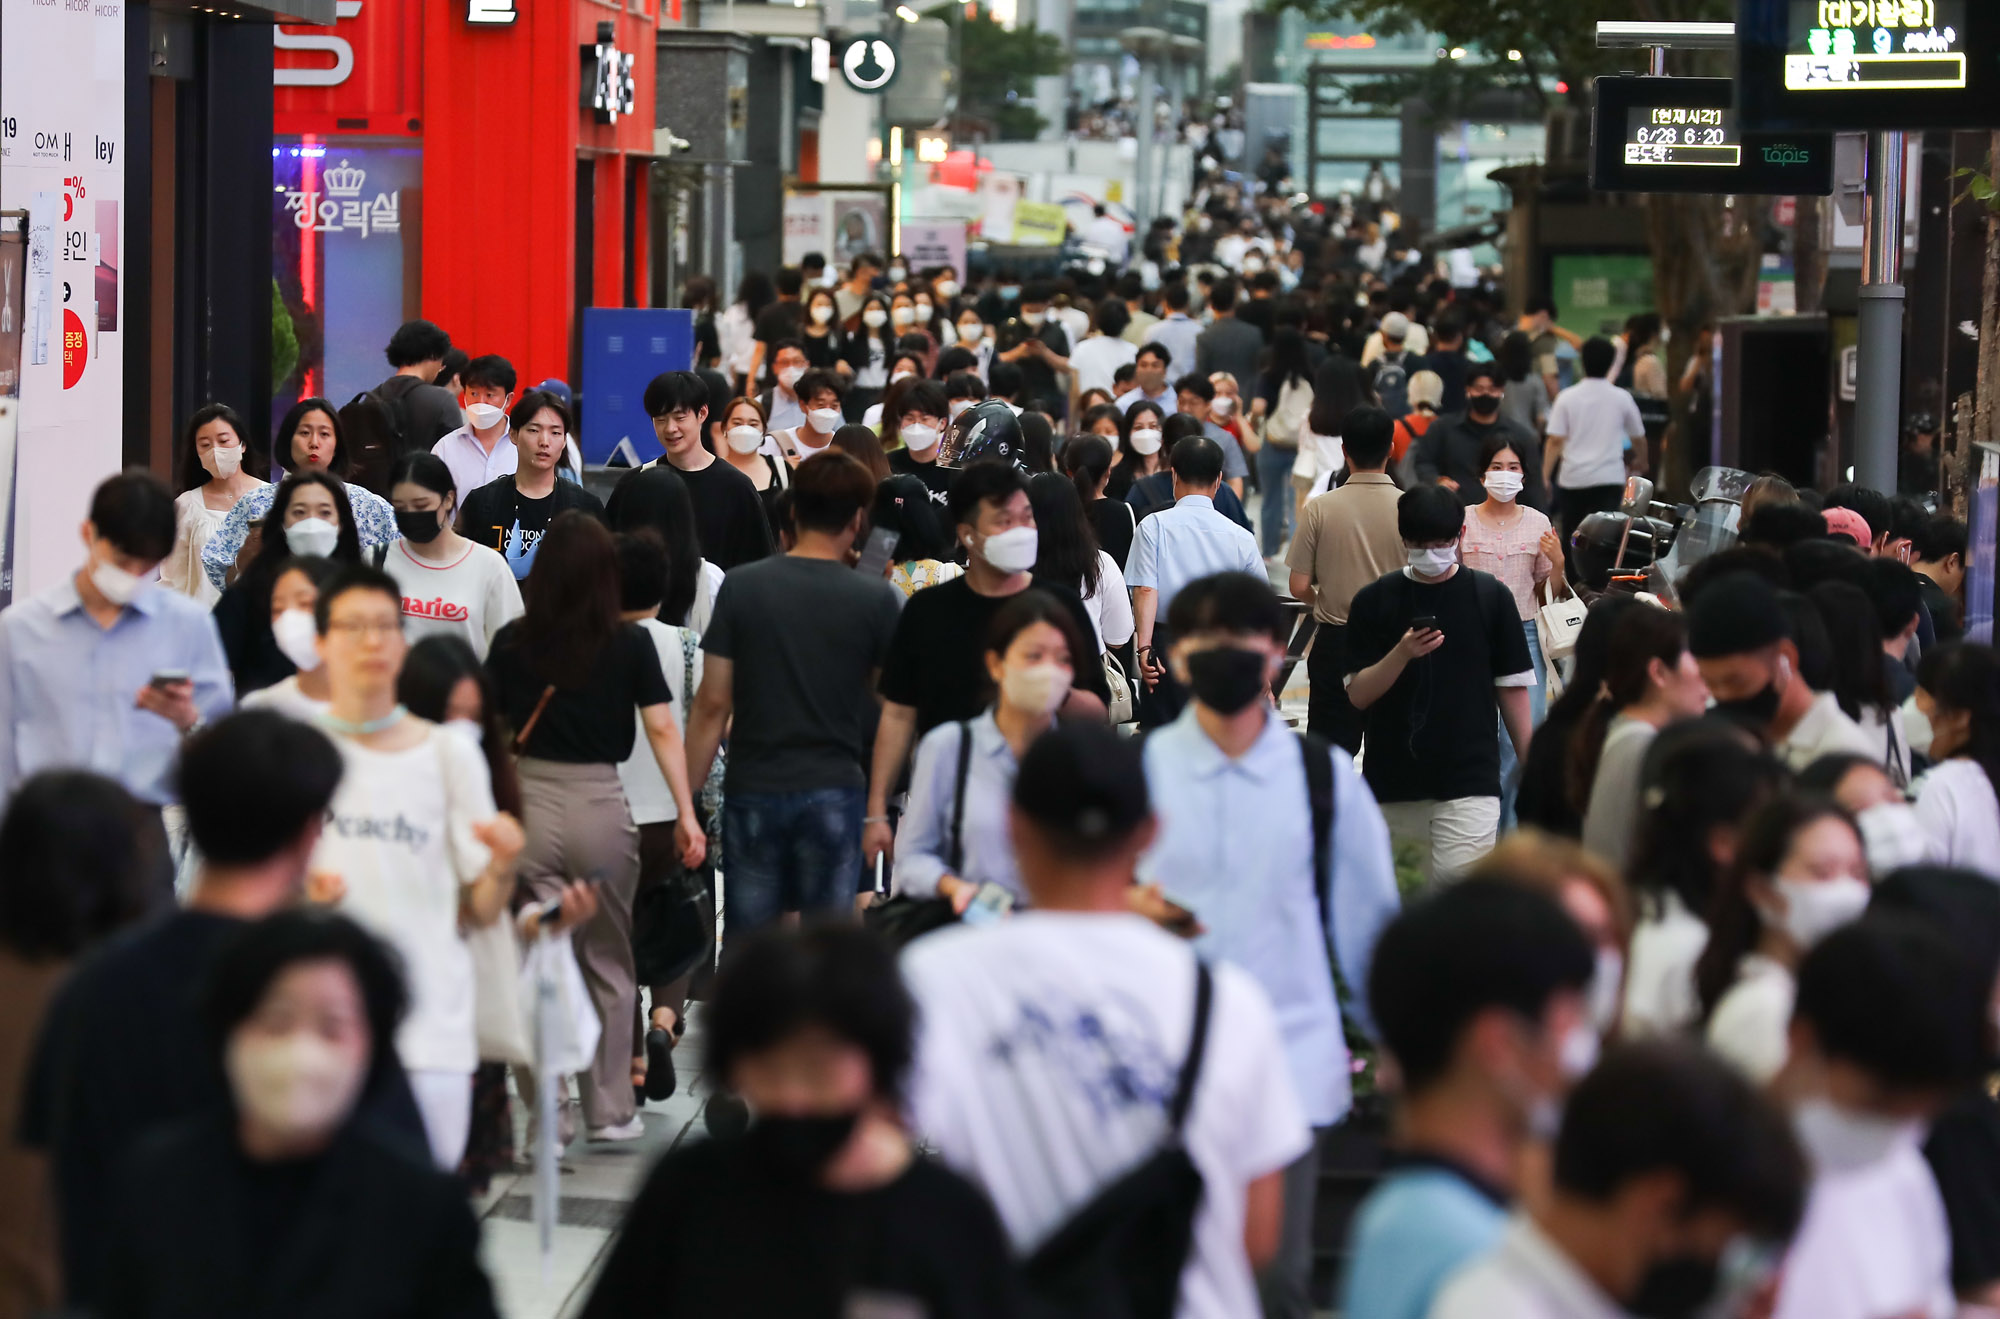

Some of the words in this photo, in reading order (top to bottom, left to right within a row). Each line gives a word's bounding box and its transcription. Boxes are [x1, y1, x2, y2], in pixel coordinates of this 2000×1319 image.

[94, 5, 119, 17] HICOR
[1652, 108, 1722, 125] [현재시각]
[1637, 127, 1677, 144] 6/28
[1684, 128, 1724, 145] 6:20
[95, 134, 115, 164] ley
[284, 190, 400, 239] 짱오락실
[65, 331, 83, 349] 증정
[505, 528, 542, 541] NTION
[325, 806, 430, 854] eachy
